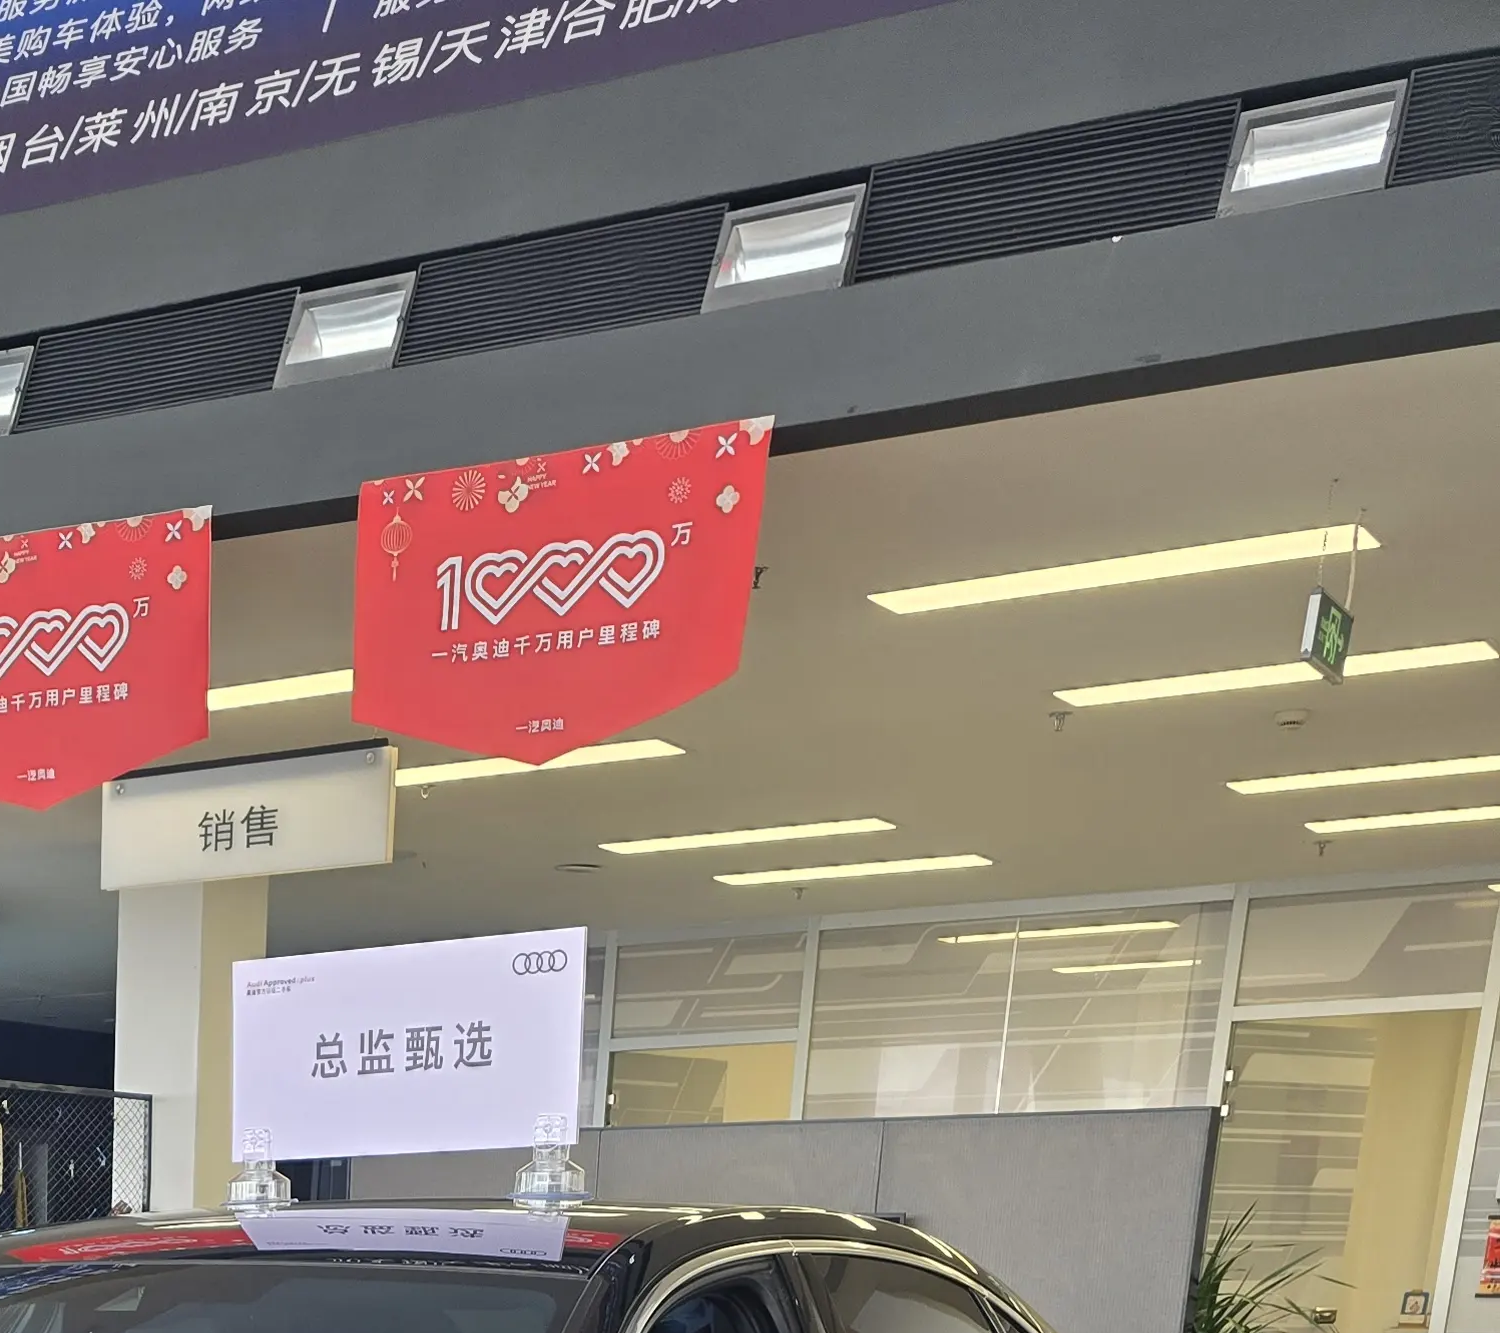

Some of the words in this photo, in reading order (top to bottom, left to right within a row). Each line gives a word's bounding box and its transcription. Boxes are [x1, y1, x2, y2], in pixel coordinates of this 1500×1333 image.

[431, 618, 661, 663] 一汽奥迪千万用户里程碑
[198, 804, 279, 852] 销售
[311, 1020, 494, 1079] 总监甄选
